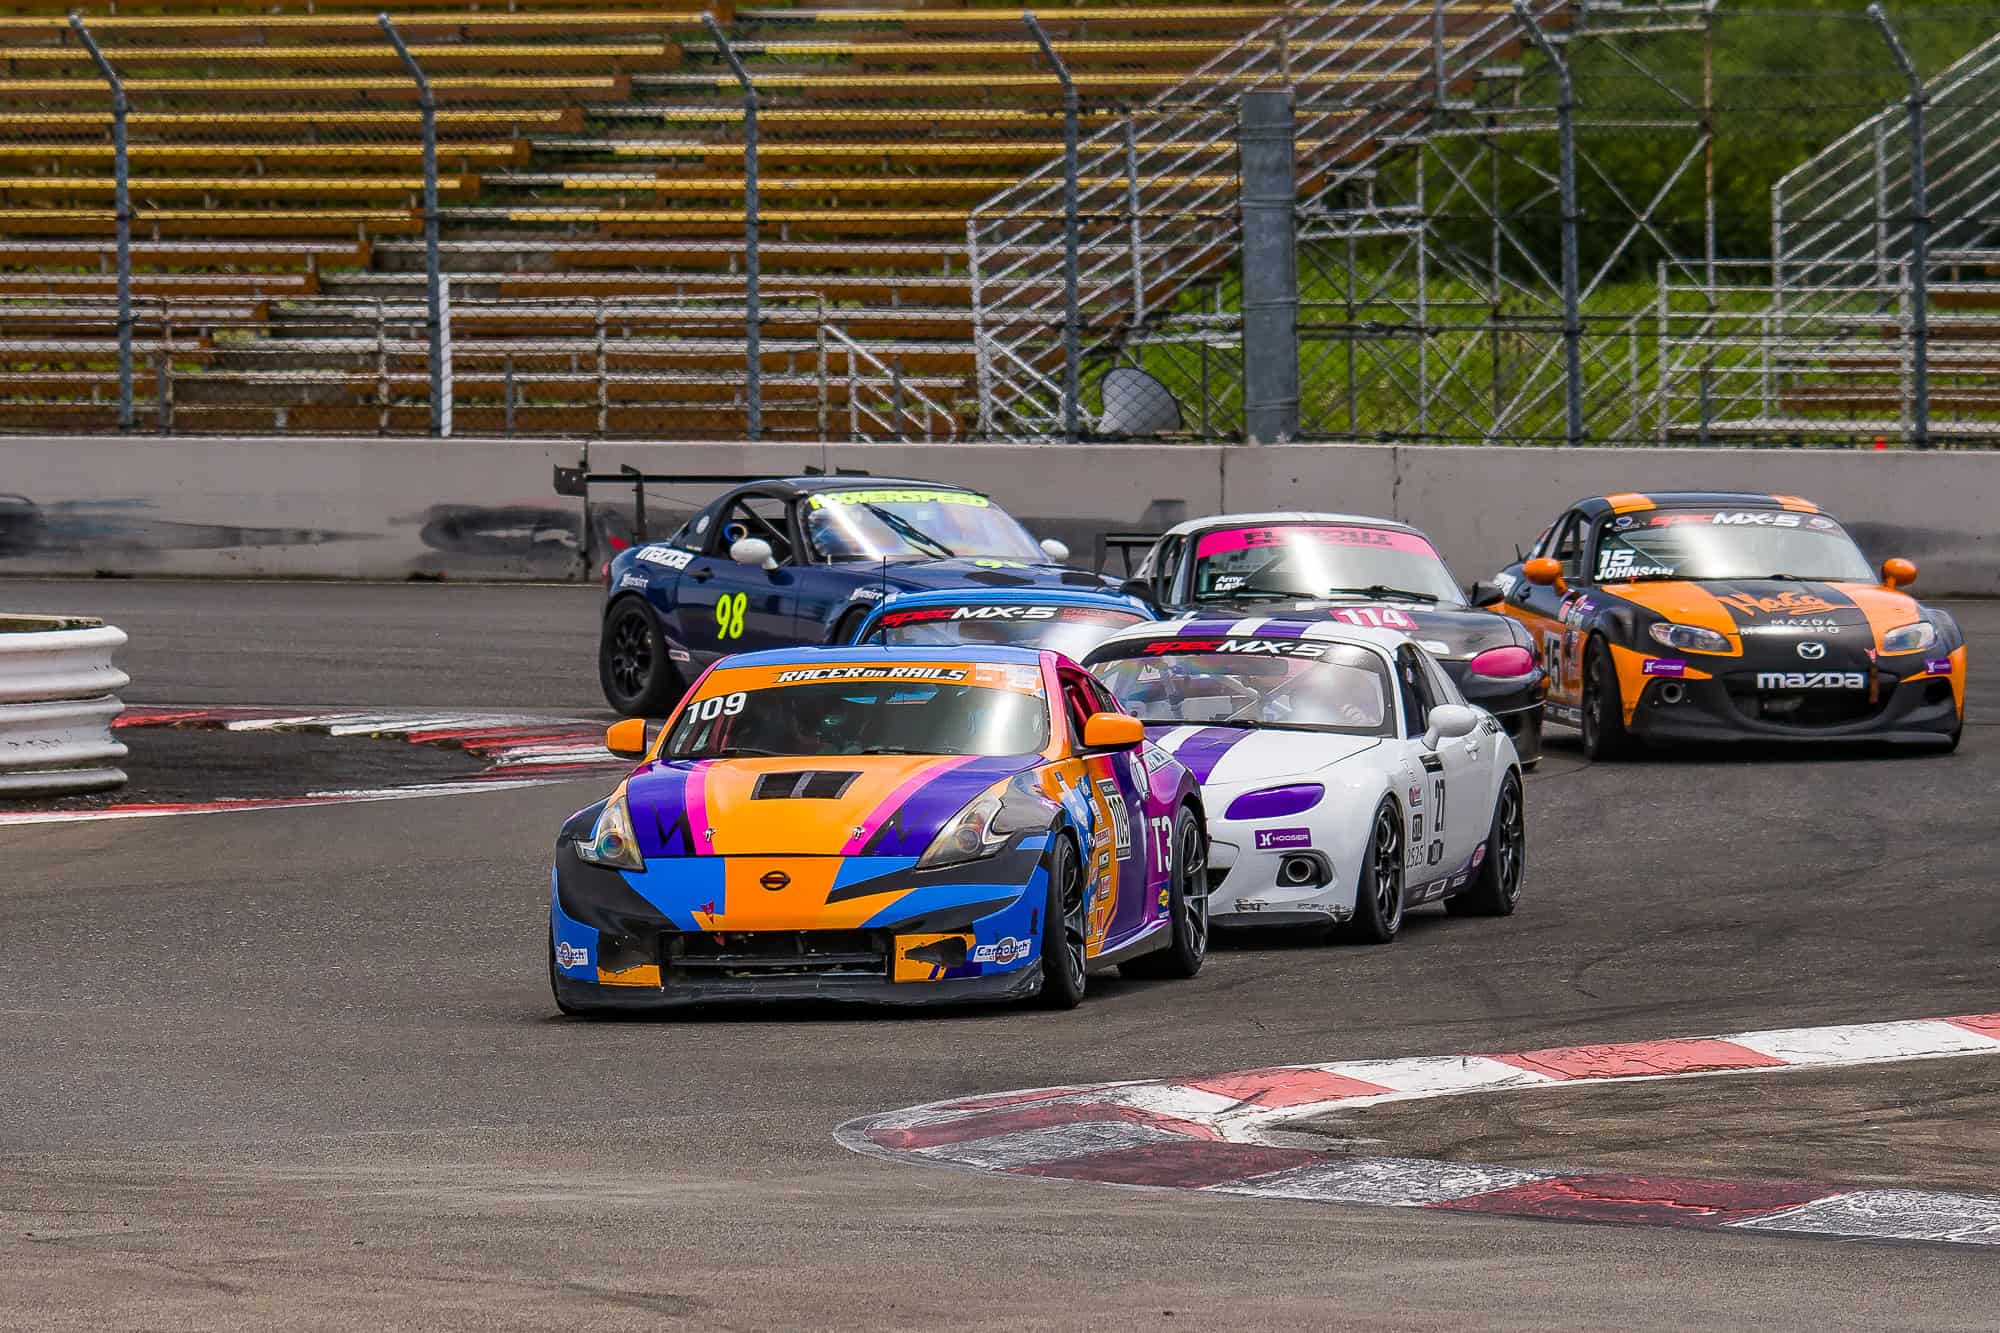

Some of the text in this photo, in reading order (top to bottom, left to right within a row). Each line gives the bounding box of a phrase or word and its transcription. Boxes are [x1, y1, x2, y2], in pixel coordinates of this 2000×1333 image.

[1711, 512, 1801, 527] MX-5
[1600, 550, 1635, 567] 15
[1595, 566, 1674, 581] JOHNSON
[716, 592, 748, 640] 98
[951, 607, 1057, 619] MX-5
[1338, 608, 1410, 628] 114
[1216, 640, 1330, 657] MX-5
[777, 667, 864, 683] RACER
[888, 667, 968, 681] RAILS
[687, 691, 747, 724] 109
[1434, 779, 1446, 833] 27
[1108, 796, 1129, 847] 109
[1152, 815, 1172, 873] T3
[976, 941, 1028, 957] Carbotech
